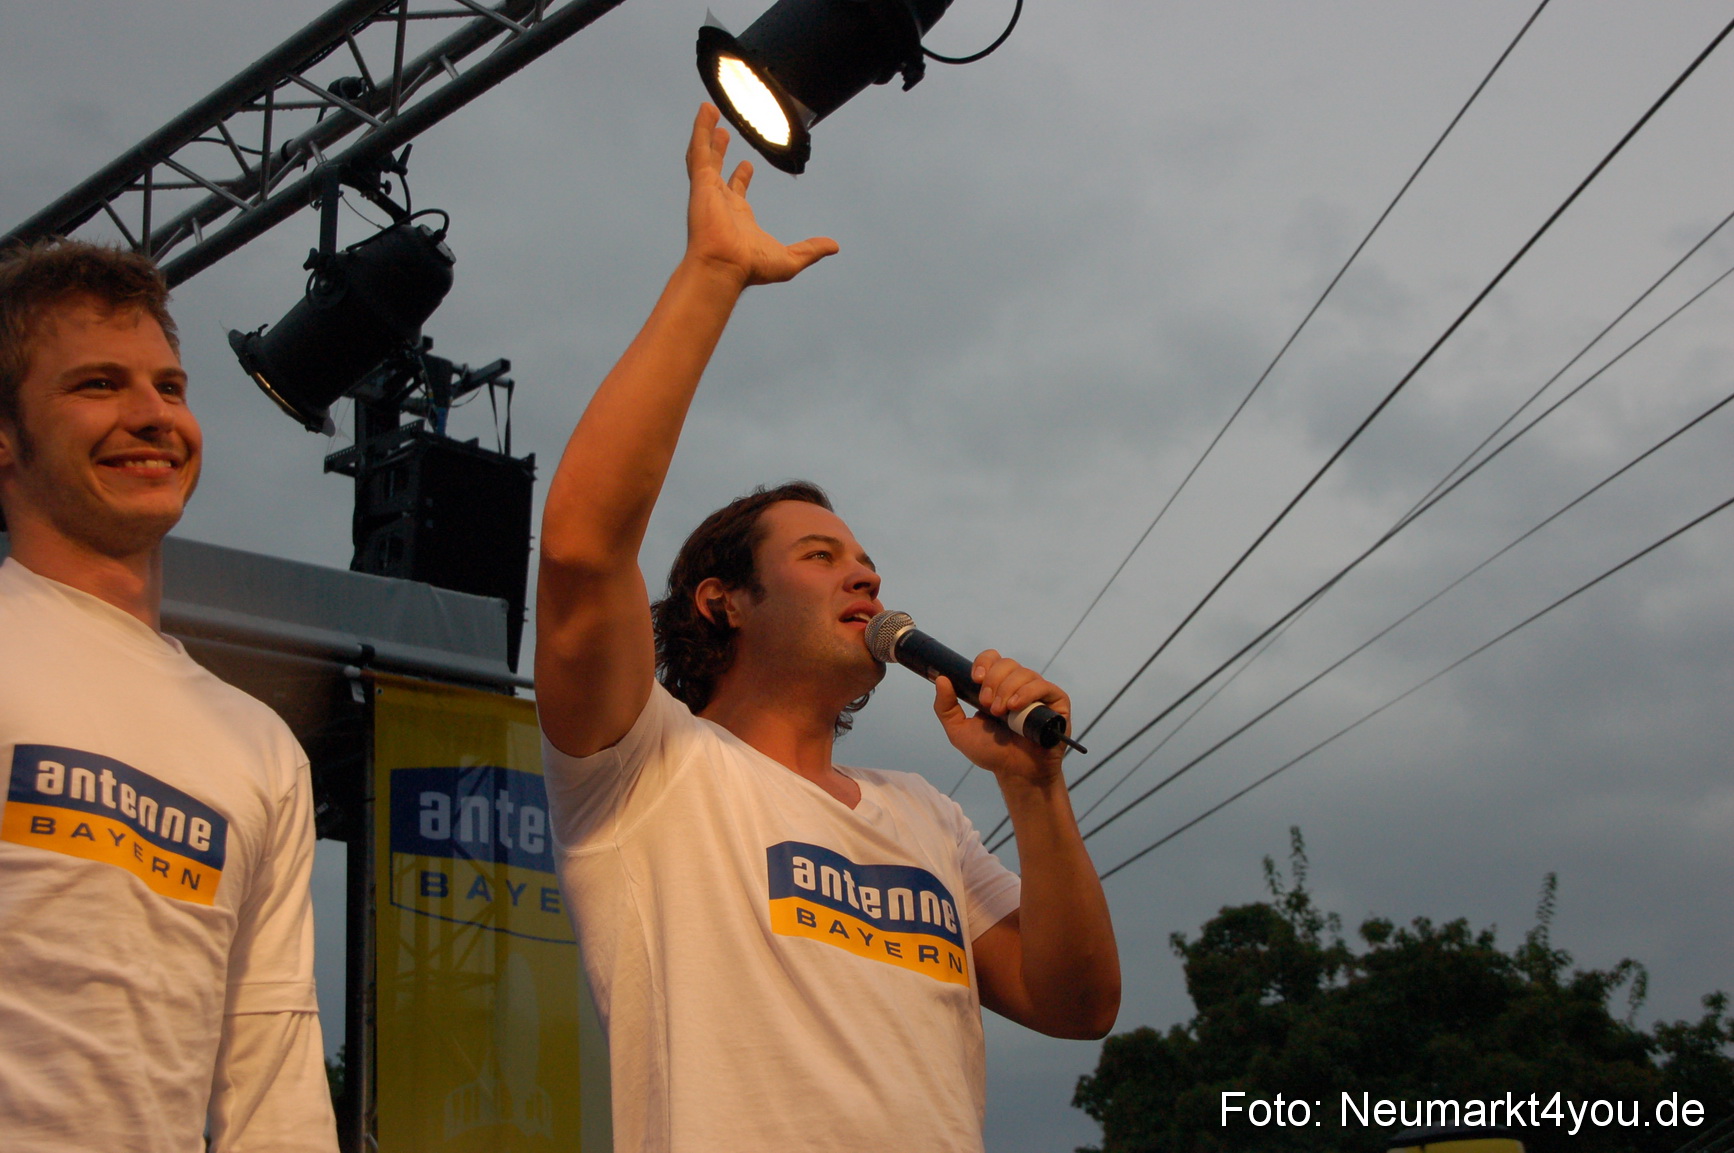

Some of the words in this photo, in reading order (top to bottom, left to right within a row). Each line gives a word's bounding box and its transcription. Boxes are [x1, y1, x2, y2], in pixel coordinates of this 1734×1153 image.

[36, 760, 212, 852] antenne
[30, 816, 202, 890] BAYERN
[792, 856, 958, 935] antenne
[796, 907, 963, 974] BAYERN
